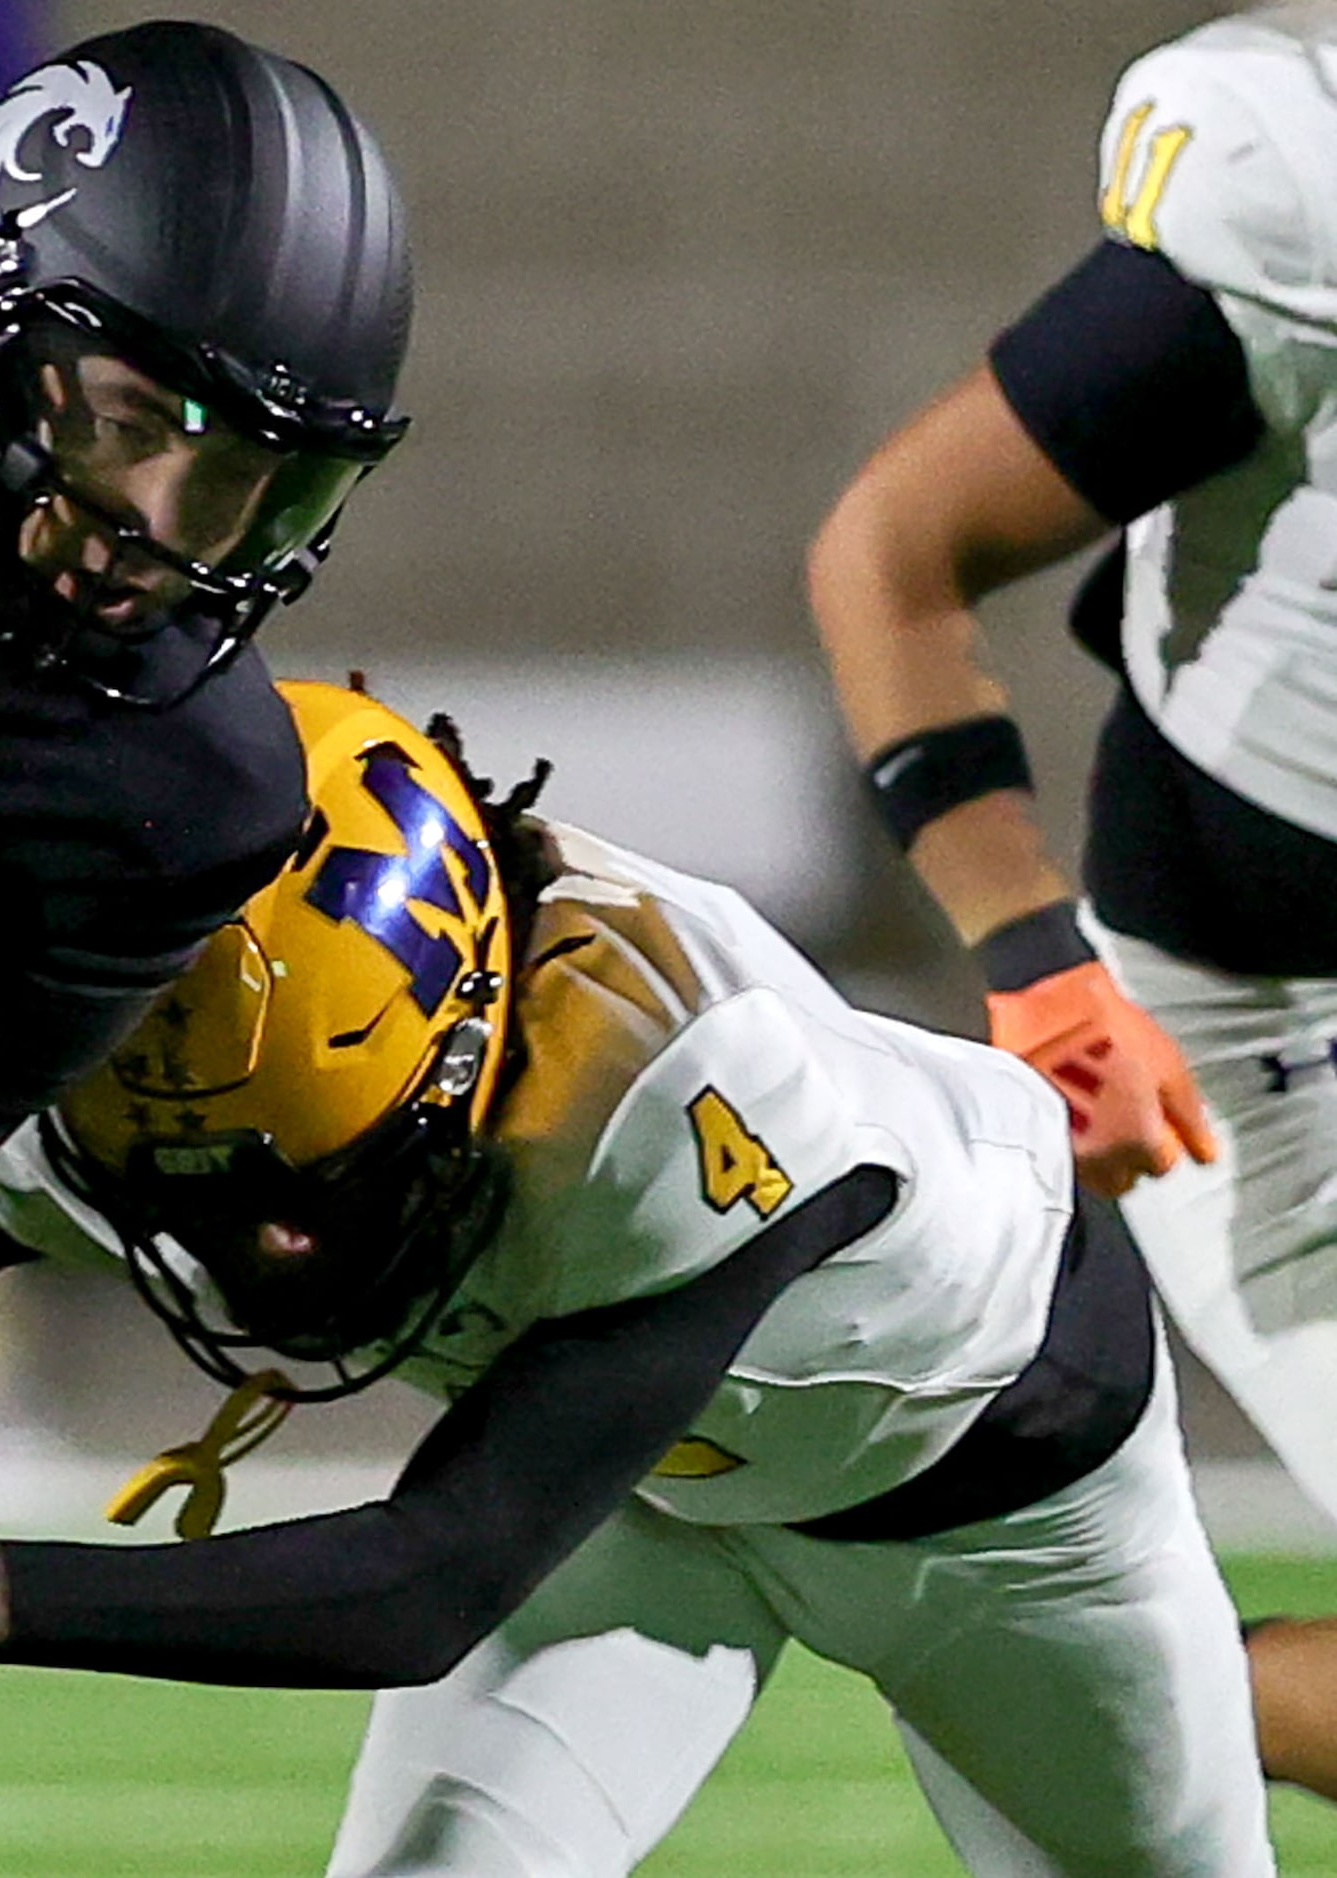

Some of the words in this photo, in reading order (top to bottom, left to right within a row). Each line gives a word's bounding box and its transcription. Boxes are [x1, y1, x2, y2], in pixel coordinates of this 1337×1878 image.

[1099, 99, 1195, 252] 11
[302, 741, 490, 1021] M
[685, 1083, 794, 1221] 4
